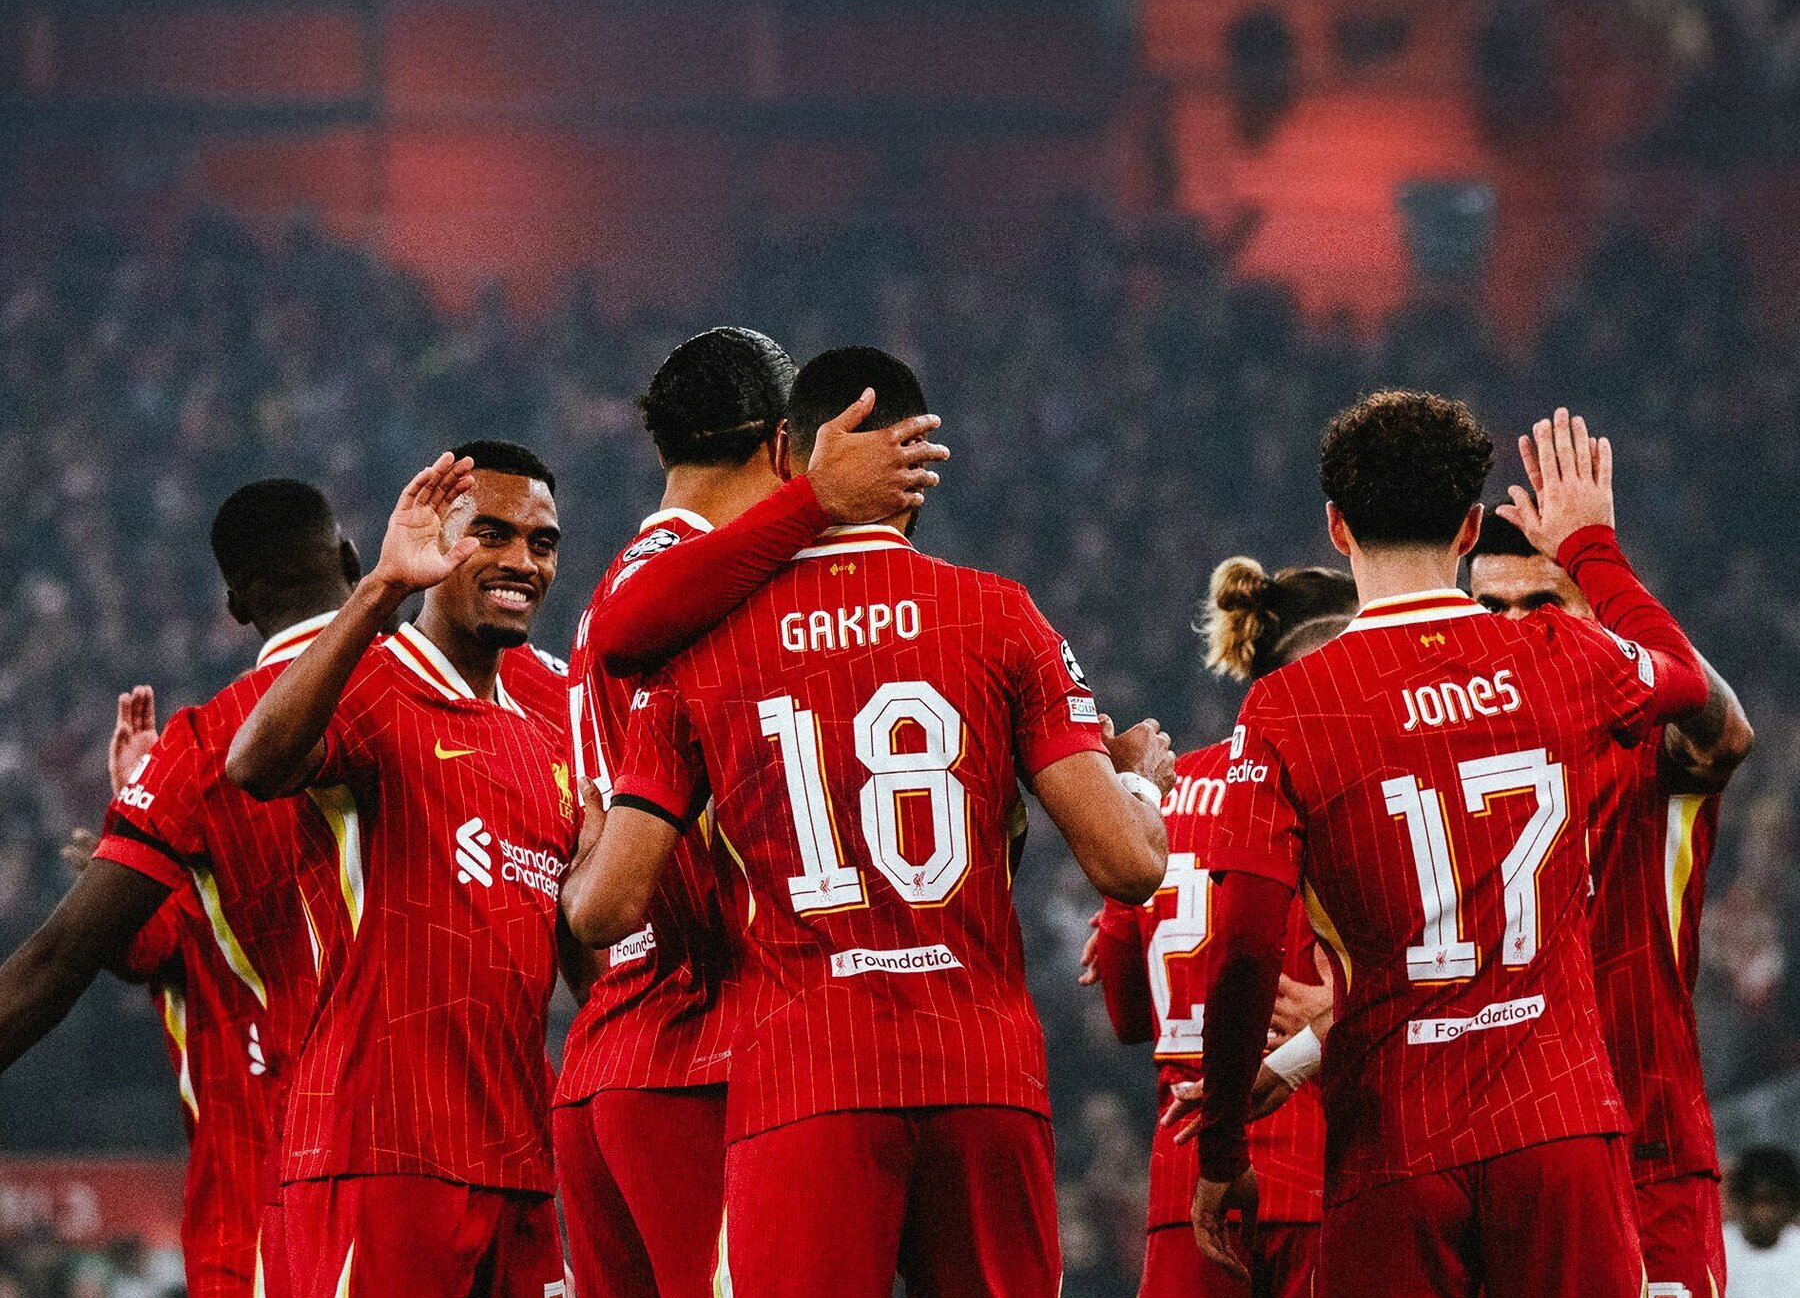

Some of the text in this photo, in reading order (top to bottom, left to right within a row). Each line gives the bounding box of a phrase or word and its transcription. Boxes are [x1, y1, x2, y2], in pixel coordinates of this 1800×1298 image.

[781, 600, 922, 652] GAKPO
[757, 681, 972, 917] 18
[1227, 758, 1268, 784] edia
[1381, 748, 1570, 986] 17
[1143, 853, 1212, 1060] 2
